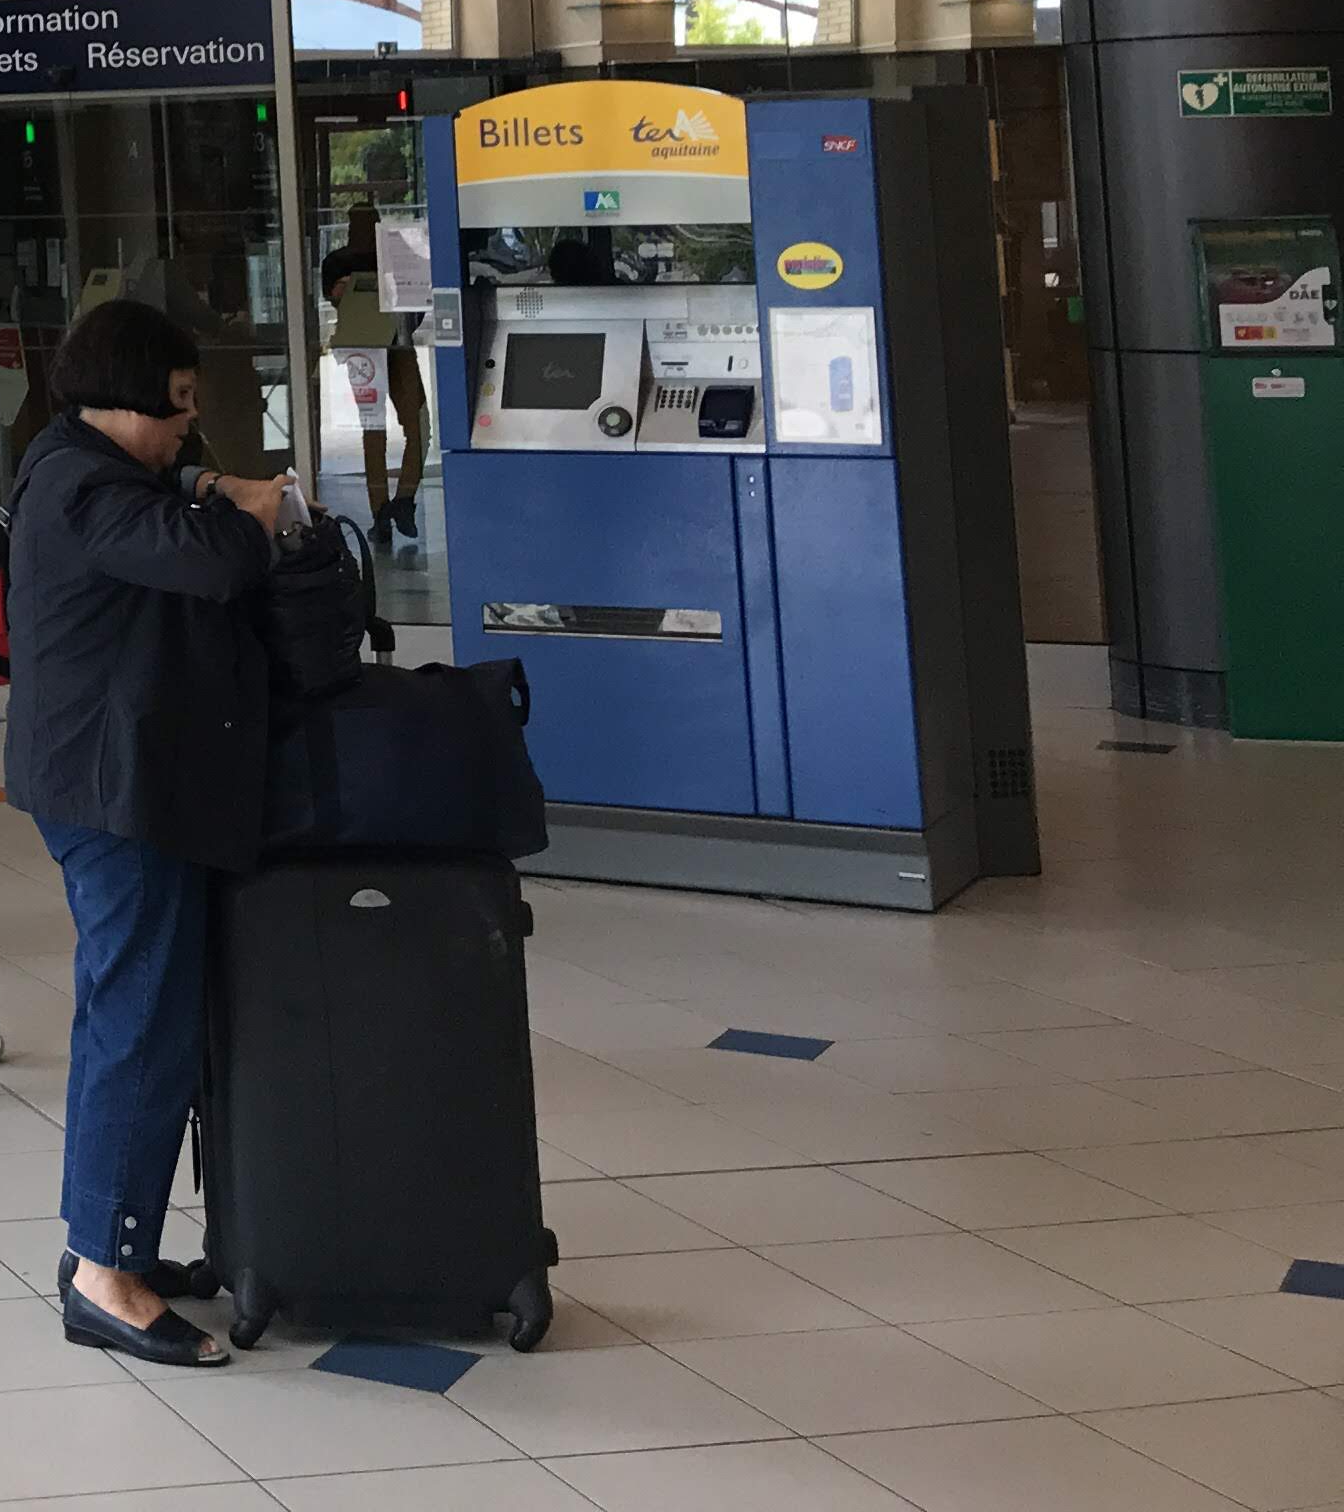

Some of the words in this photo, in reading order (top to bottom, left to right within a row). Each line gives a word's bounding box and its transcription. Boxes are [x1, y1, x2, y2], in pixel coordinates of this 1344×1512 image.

[87, 37, 265, 70] Réservation
[479, 118, 585, 149] Billets
[651, 142, 721, 162] aquitaine
[823, 137, 858, 153] SNCF
[1288, 288, 1320, 300] DAE
